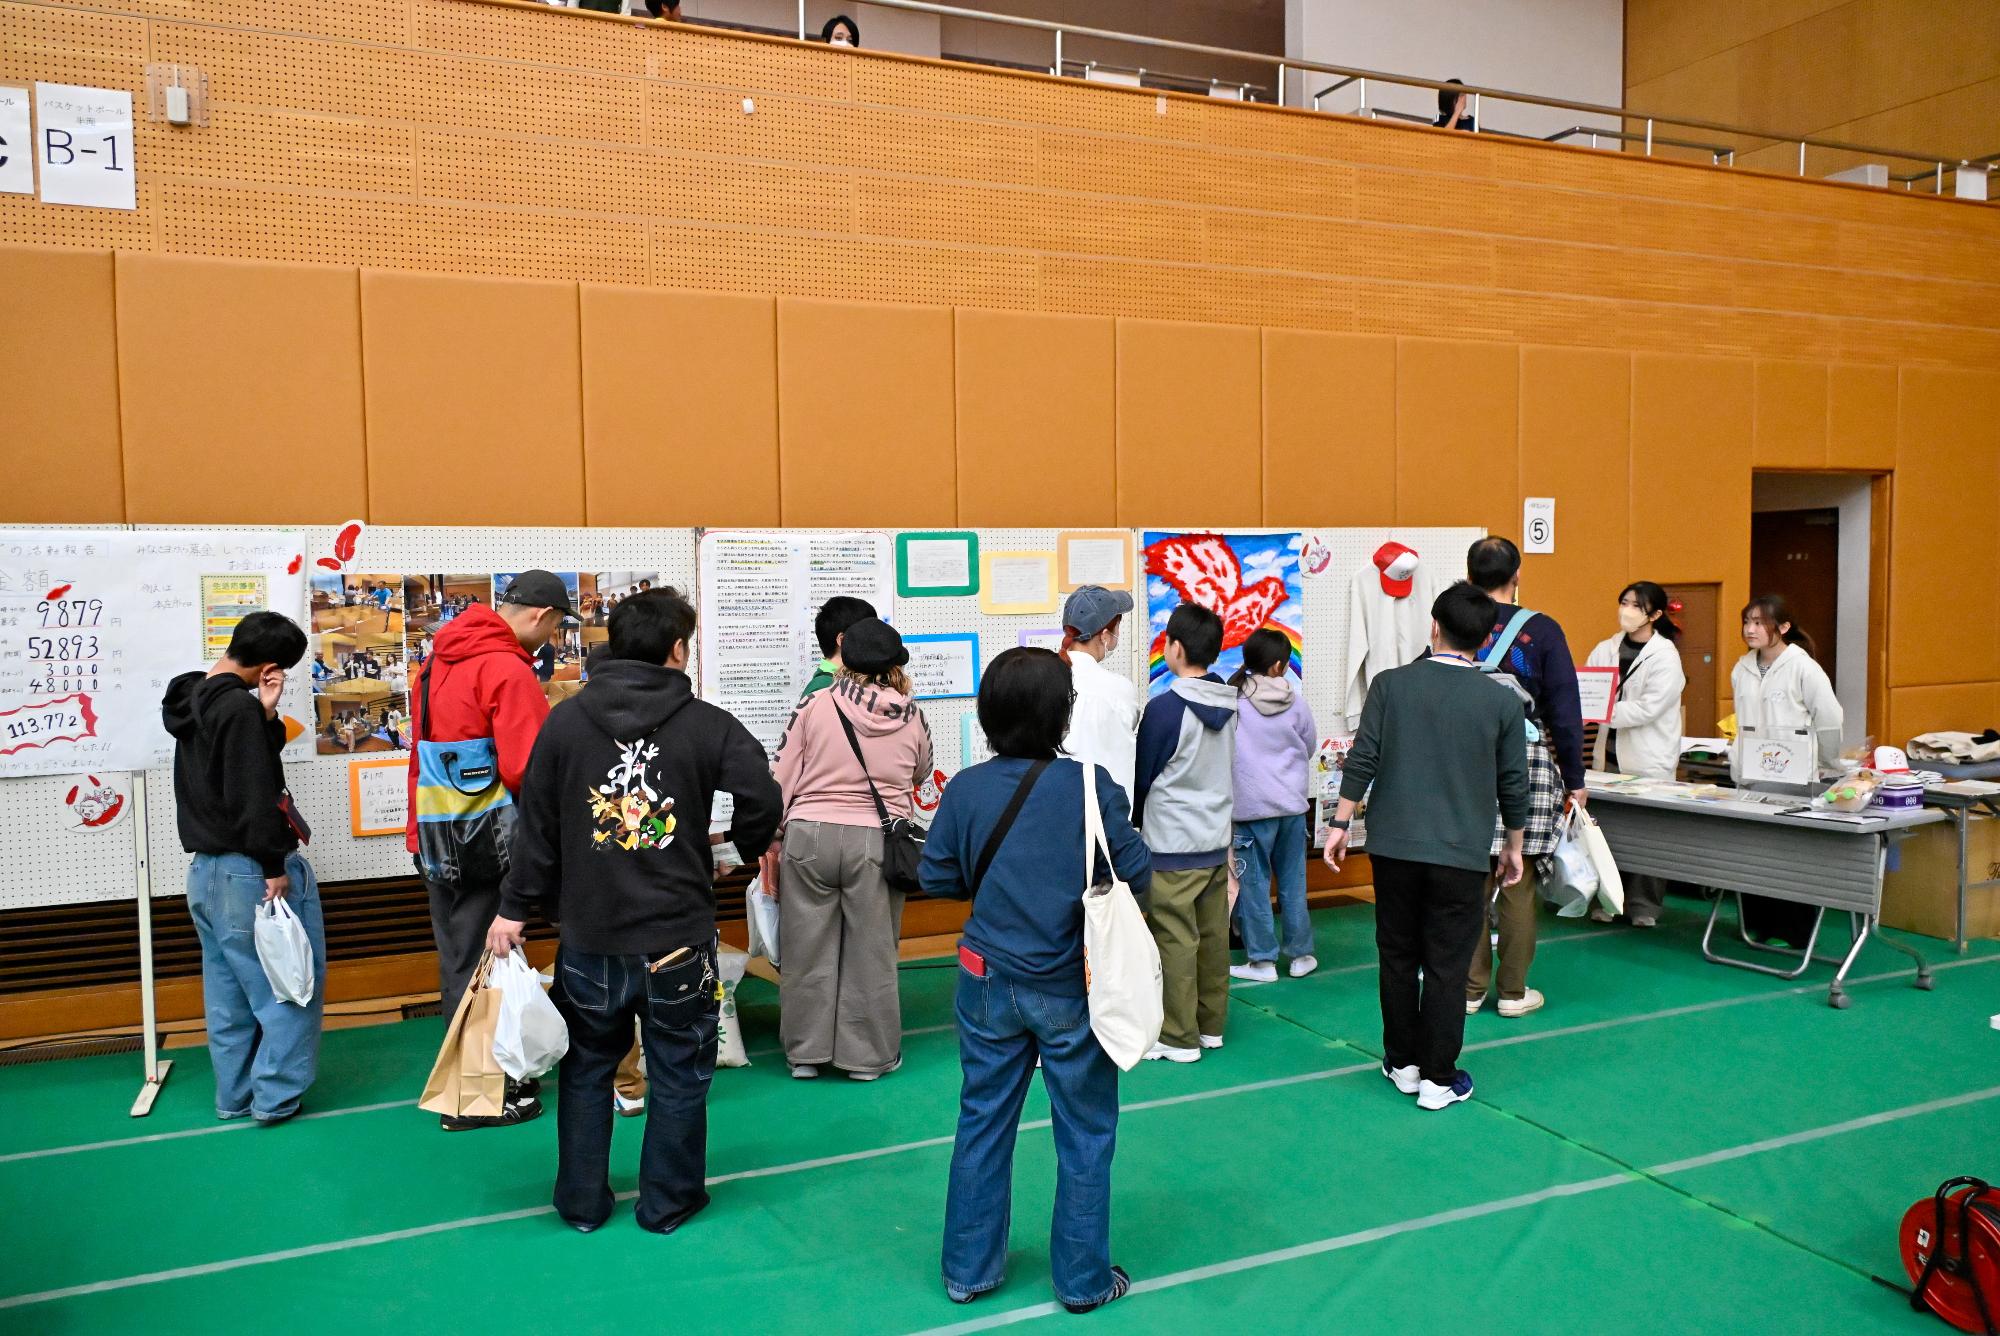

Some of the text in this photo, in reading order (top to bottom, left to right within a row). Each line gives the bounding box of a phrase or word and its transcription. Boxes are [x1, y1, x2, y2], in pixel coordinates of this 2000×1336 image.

[46, 128, 124, 171] B-1
[37, 599, 103, 627] 9879
[28, 634, 99, 661] 52893
[46, 662, 99, 676] 3000
[29, 676, 99, 694] 48000
